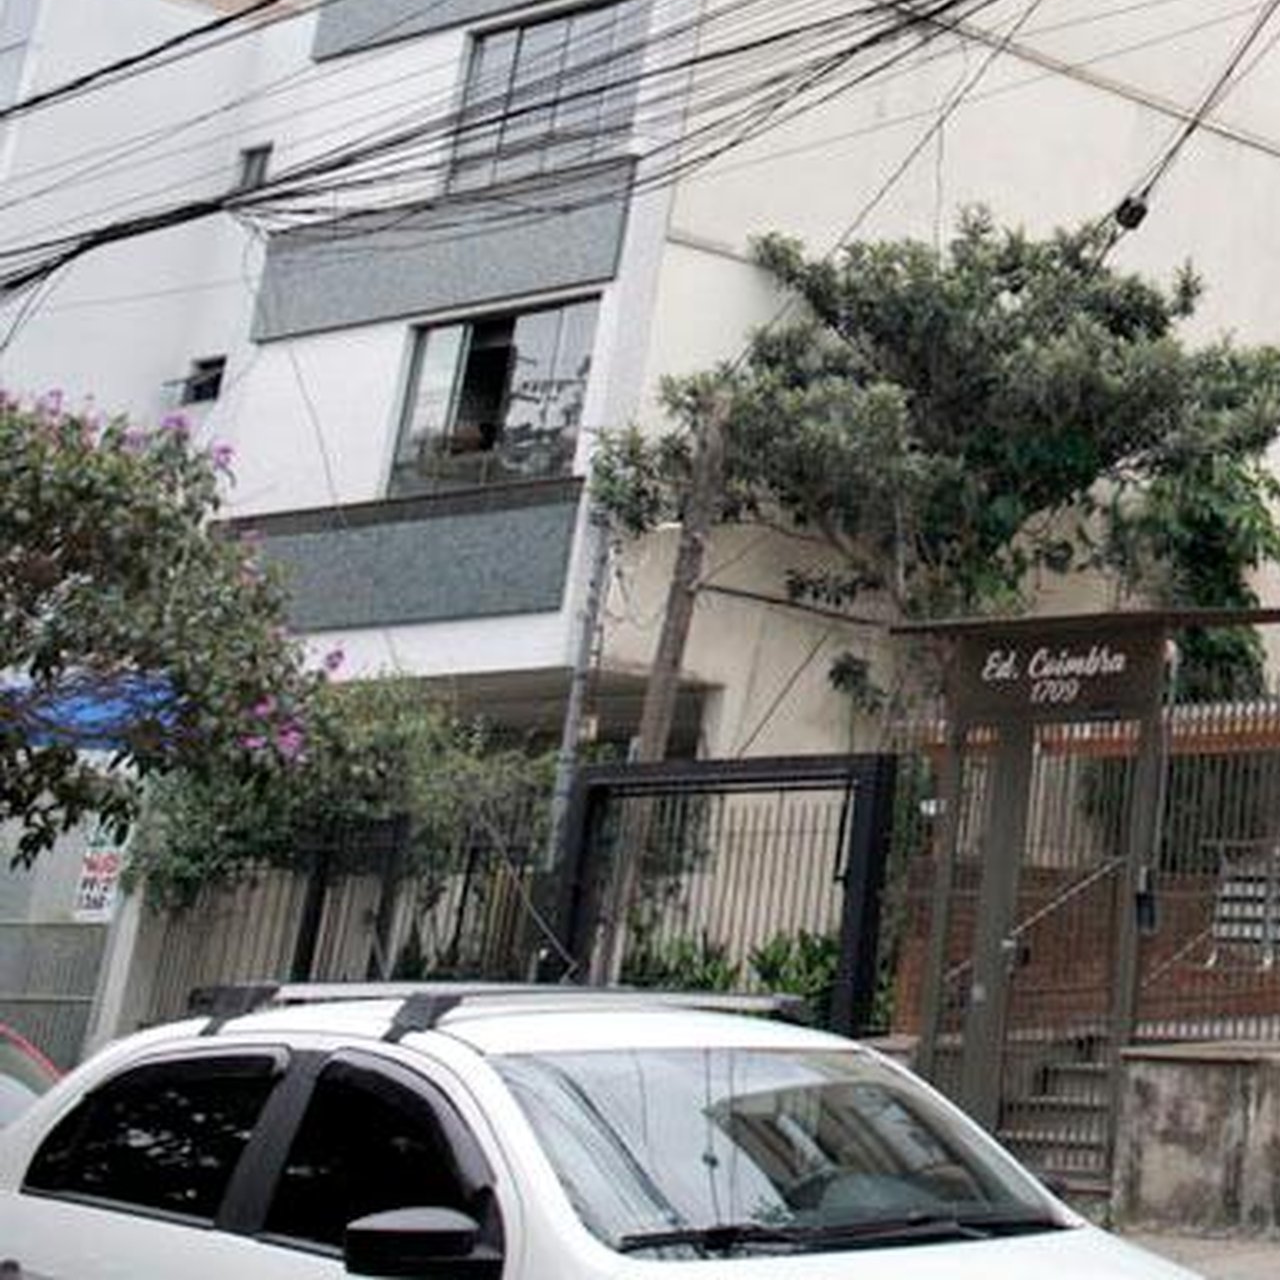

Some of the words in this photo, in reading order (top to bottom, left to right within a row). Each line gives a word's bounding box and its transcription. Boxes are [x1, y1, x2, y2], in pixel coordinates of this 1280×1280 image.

[982, 649, 1019, 681] Ed.
[1028, 645, 1126, 678] Coimbra
[1030, 678, 1079, 703] 1709
